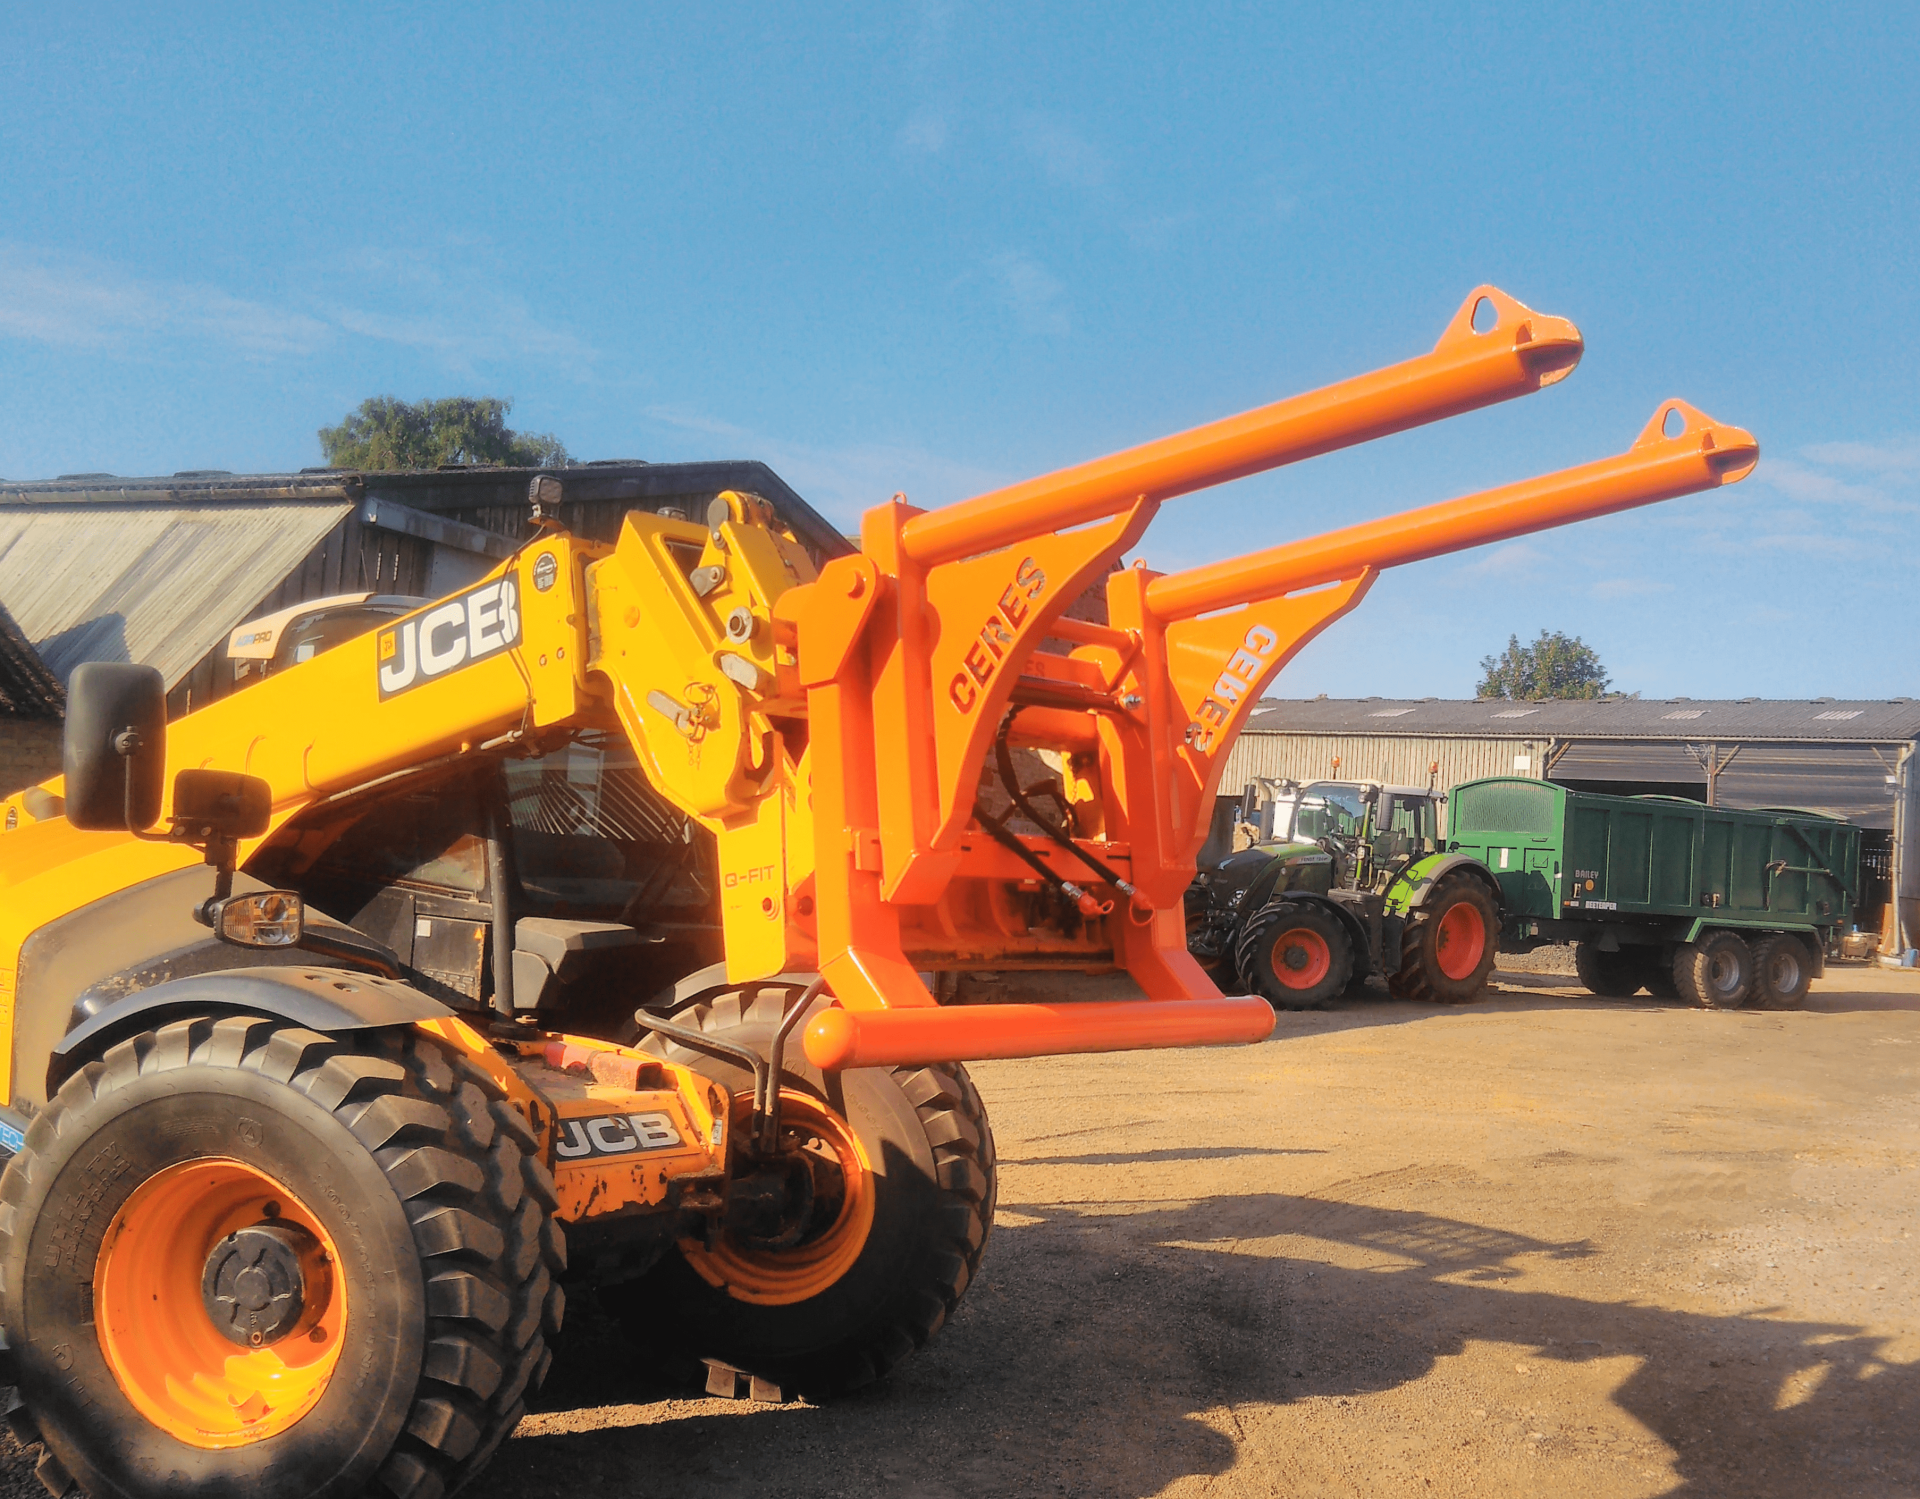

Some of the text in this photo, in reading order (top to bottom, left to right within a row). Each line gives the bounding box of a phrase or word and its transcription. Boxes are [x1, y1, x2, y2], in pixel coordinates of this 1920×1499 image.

[380, 580, 519, 693] JCB
[950, 557, 1045, 715] CERES
[725, 864, 776, 888] Q-FIT
[1575, 869, 1599, 879] BAILEY
[556, 1113, 681, 1157] JCB
[44, 1140, 121, 1268] UTILITY
